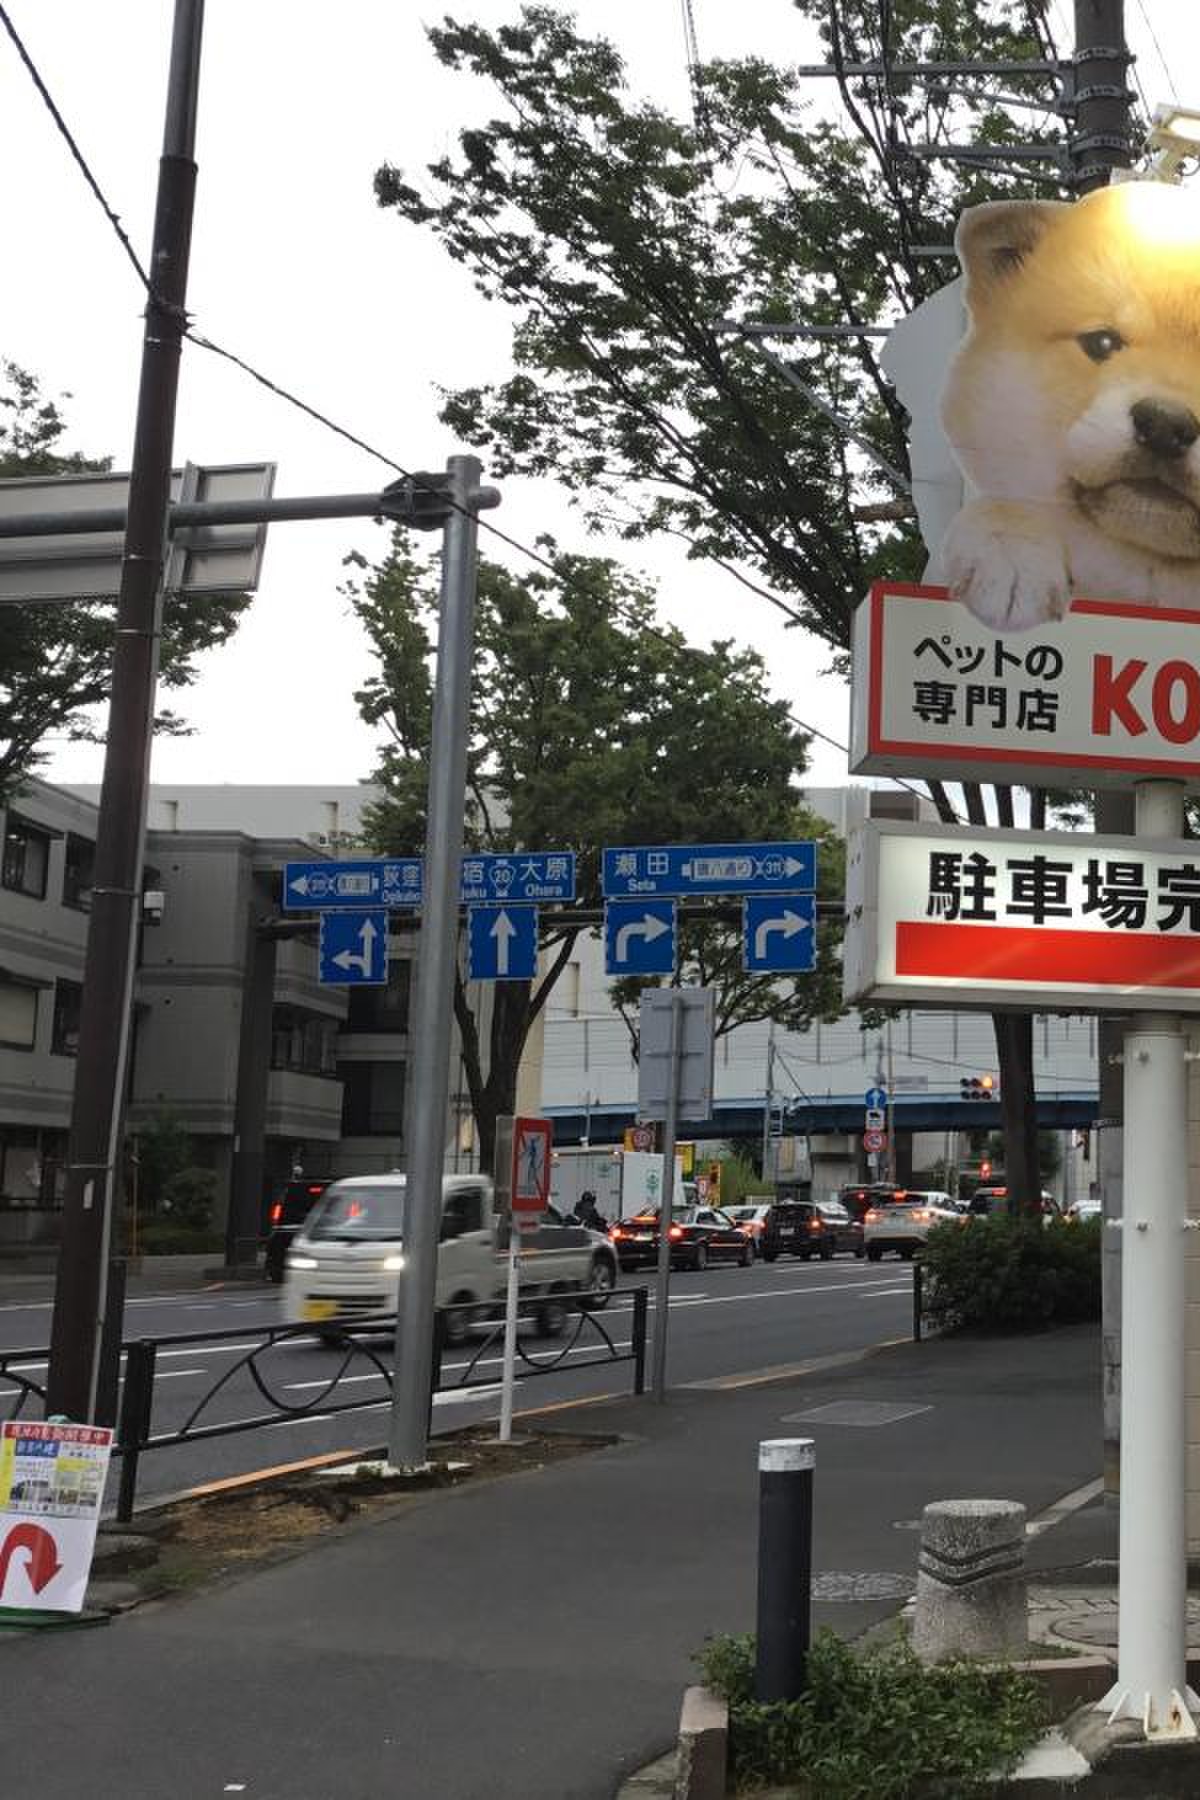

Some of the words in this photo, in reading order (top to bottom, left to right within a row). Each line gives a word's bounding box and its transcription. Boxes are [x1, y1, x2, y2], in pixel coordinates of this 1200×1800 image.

[913, 635, 1063, 680] ペットの
[912, 681, 1059, 733] 専門店
[495, 868, 511, 883] 20
[520, 857, 568, 881] 大原
[613, 852, 669, 876] 瀬田
